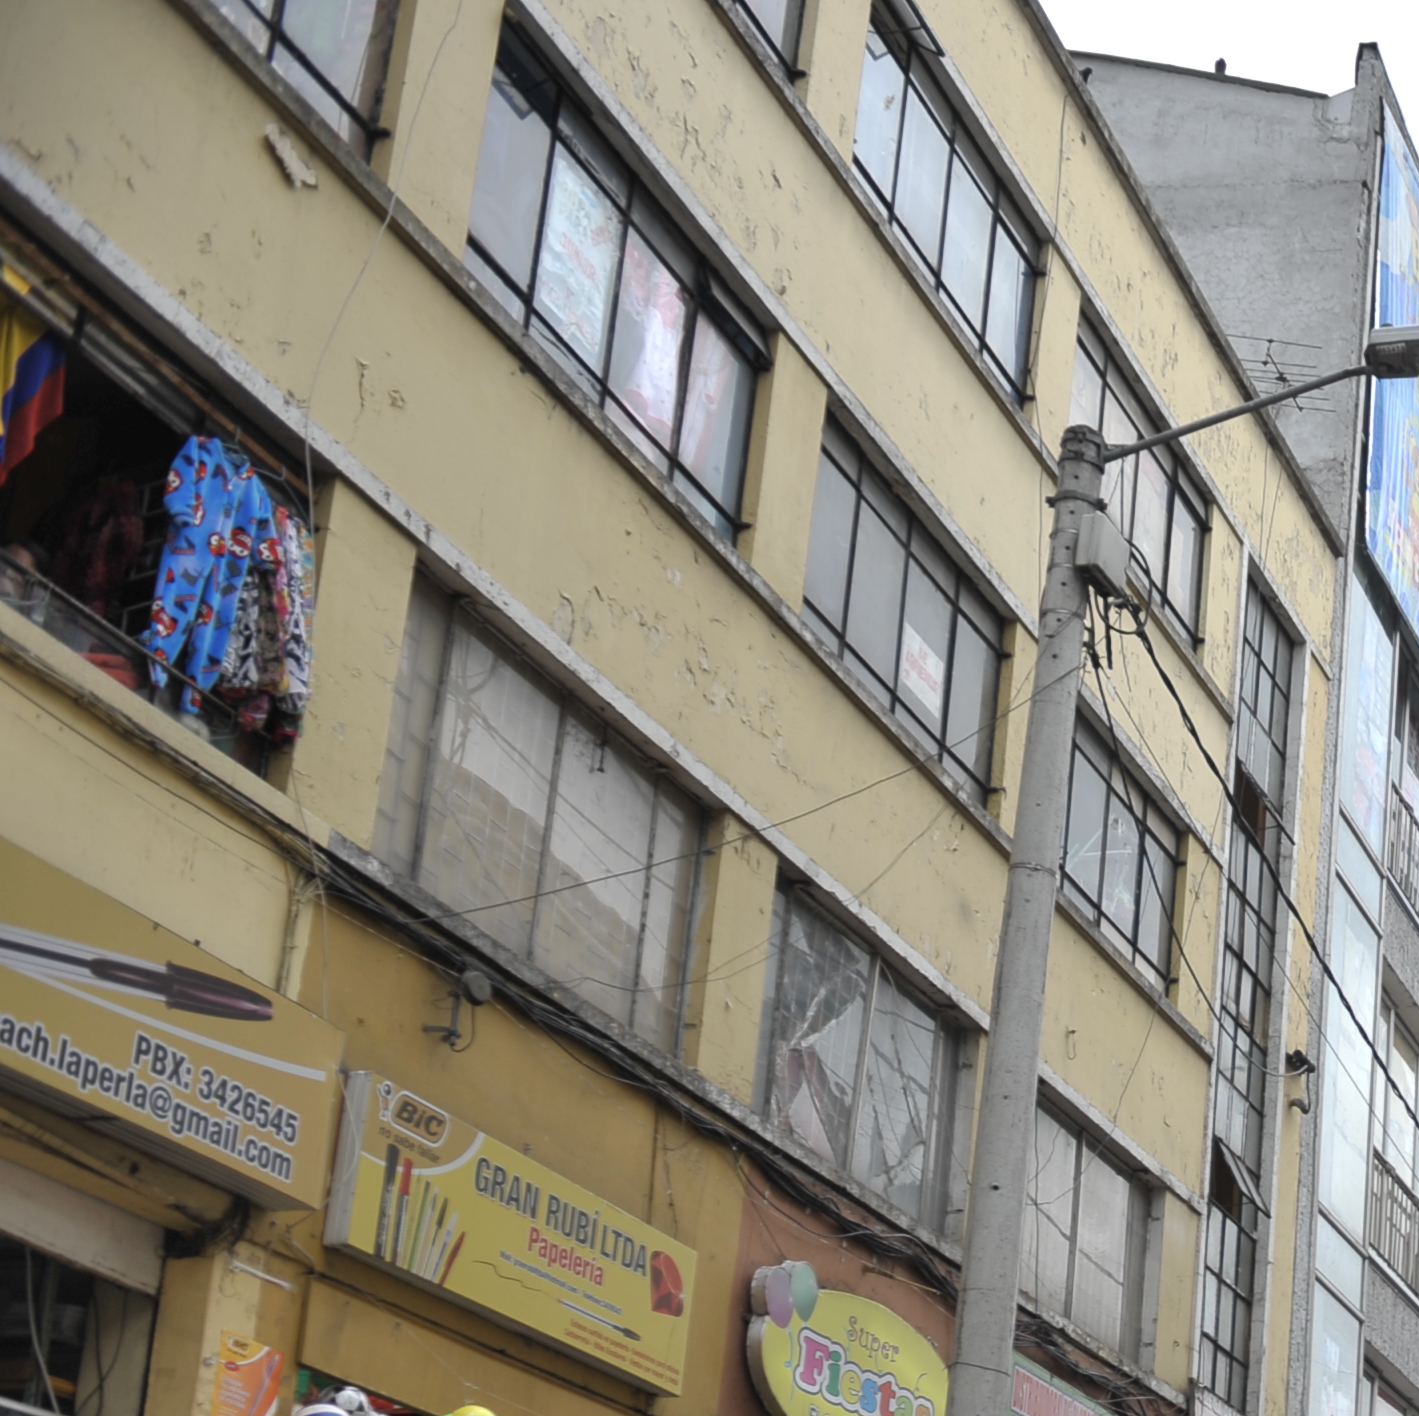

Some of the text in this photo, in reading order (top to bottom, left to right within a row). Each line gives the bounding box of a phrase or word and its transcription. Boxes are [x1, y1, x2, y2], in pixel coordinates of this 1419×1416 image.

[132, 1033, 298, 1145] PBX: 3426545
[474, 1155, 541, 1222] GRAN
[600, 1223, 649, 1278] LTDA
[849, 1315, 899, 1363] Super
